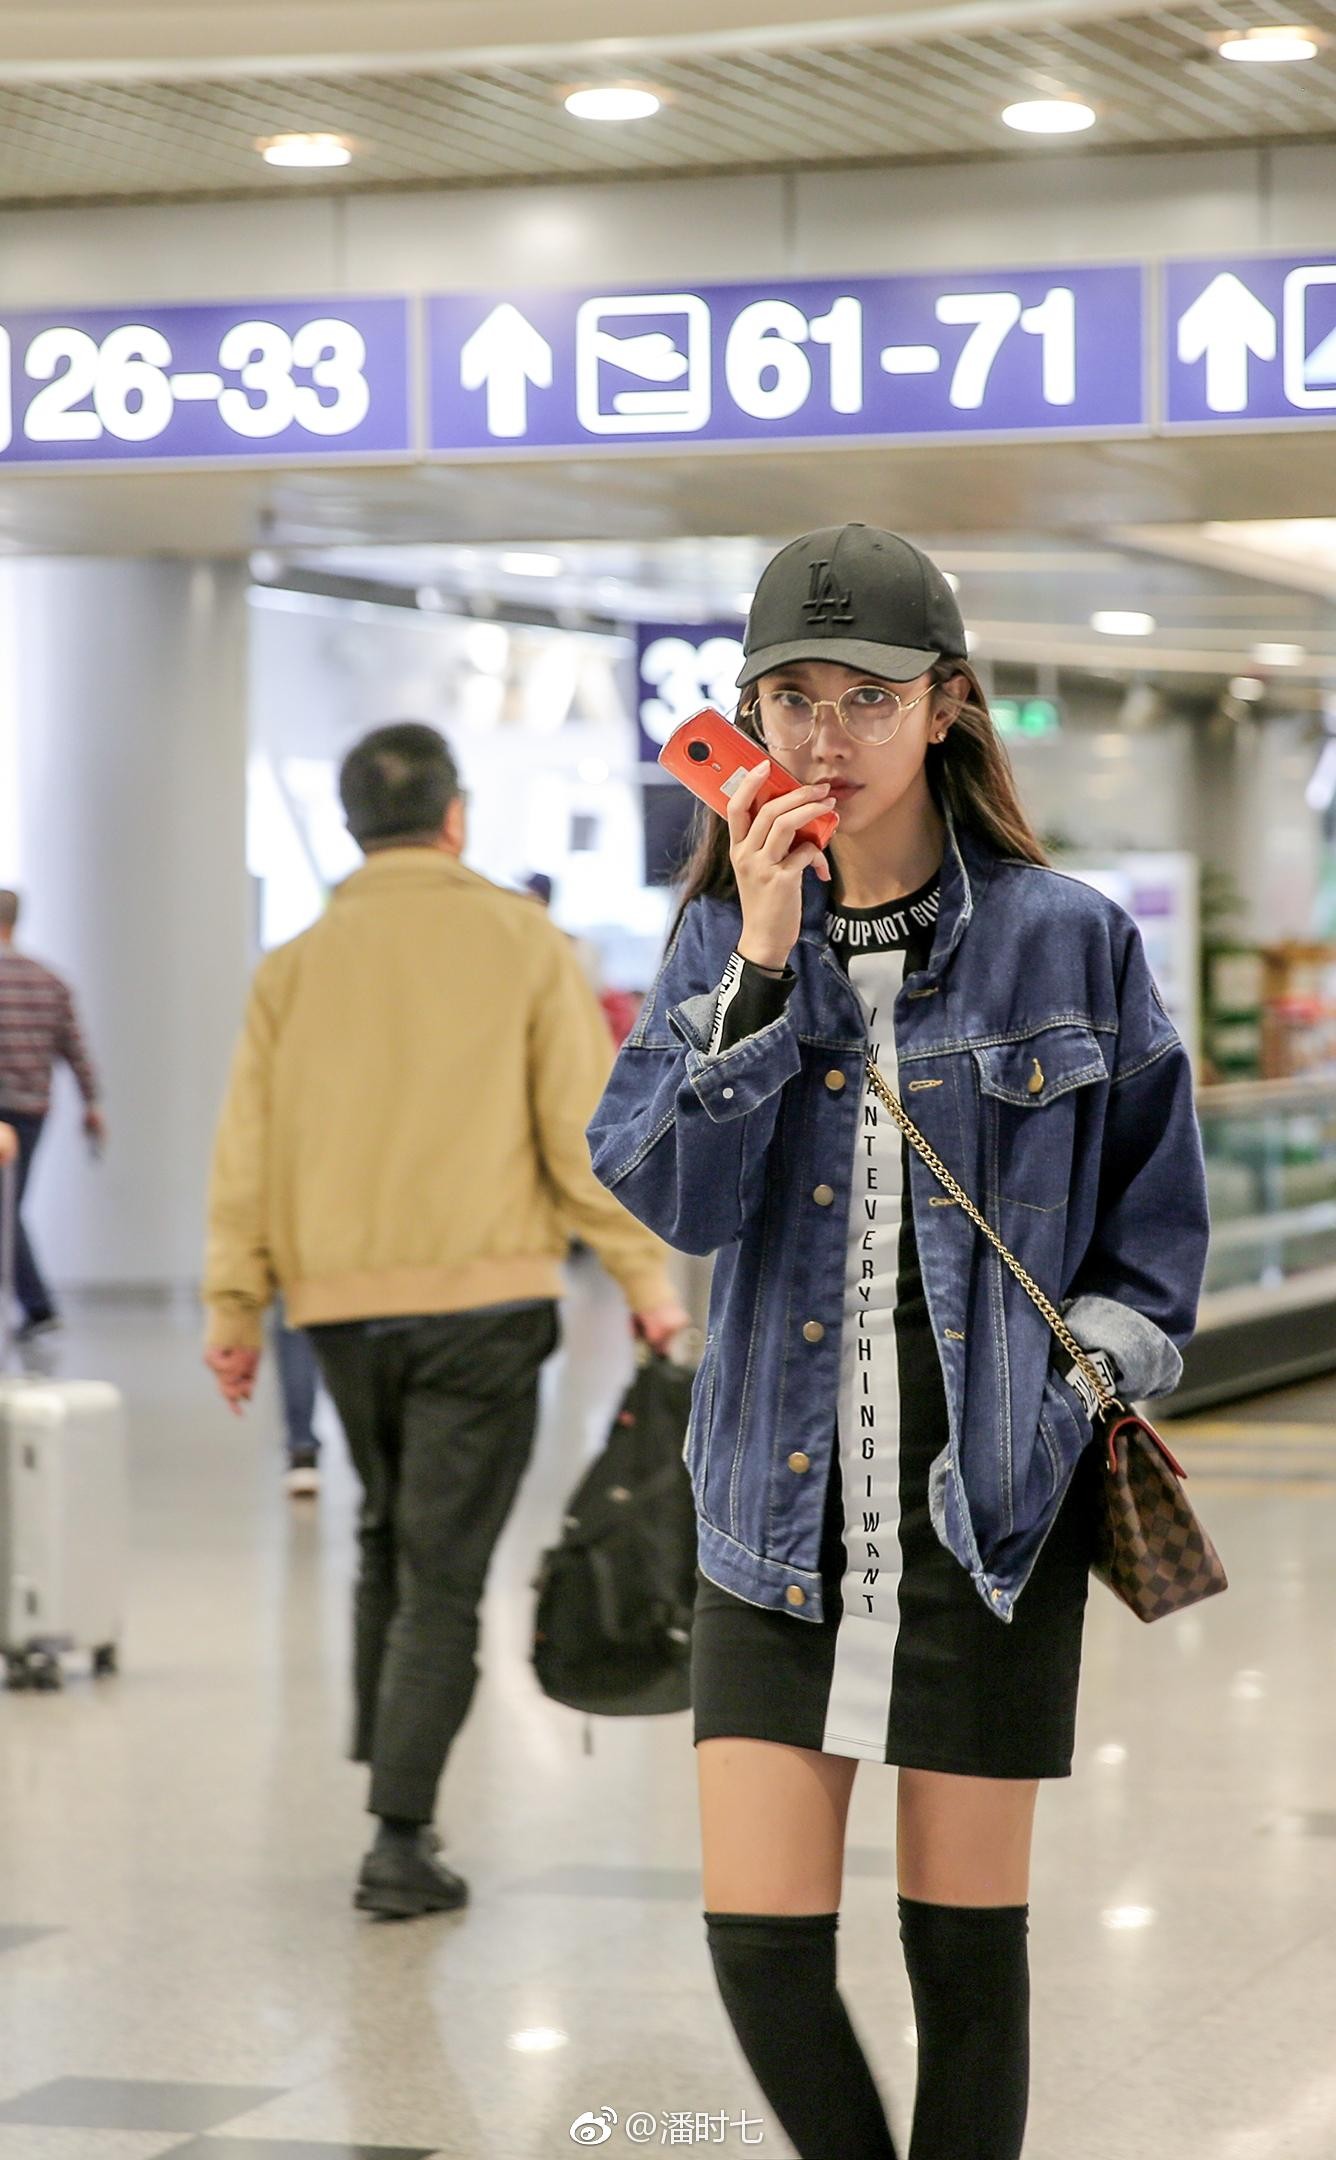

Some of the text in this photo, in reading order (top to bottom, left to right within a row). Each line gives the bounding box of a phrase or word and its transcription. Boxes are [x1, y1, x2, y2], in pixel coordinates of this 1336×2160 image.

[23, 318, 370, 442] 26-33
[725, 287, 1077, 420] 61-71
[802, 559, 855, 625] LA
[848, 920, 872, 946] UP
[871, 911, 910, 945] NOT
[855, 1166, 878, 1460] EVERYTHING
[863, 1511, 880, 1614] WANT
